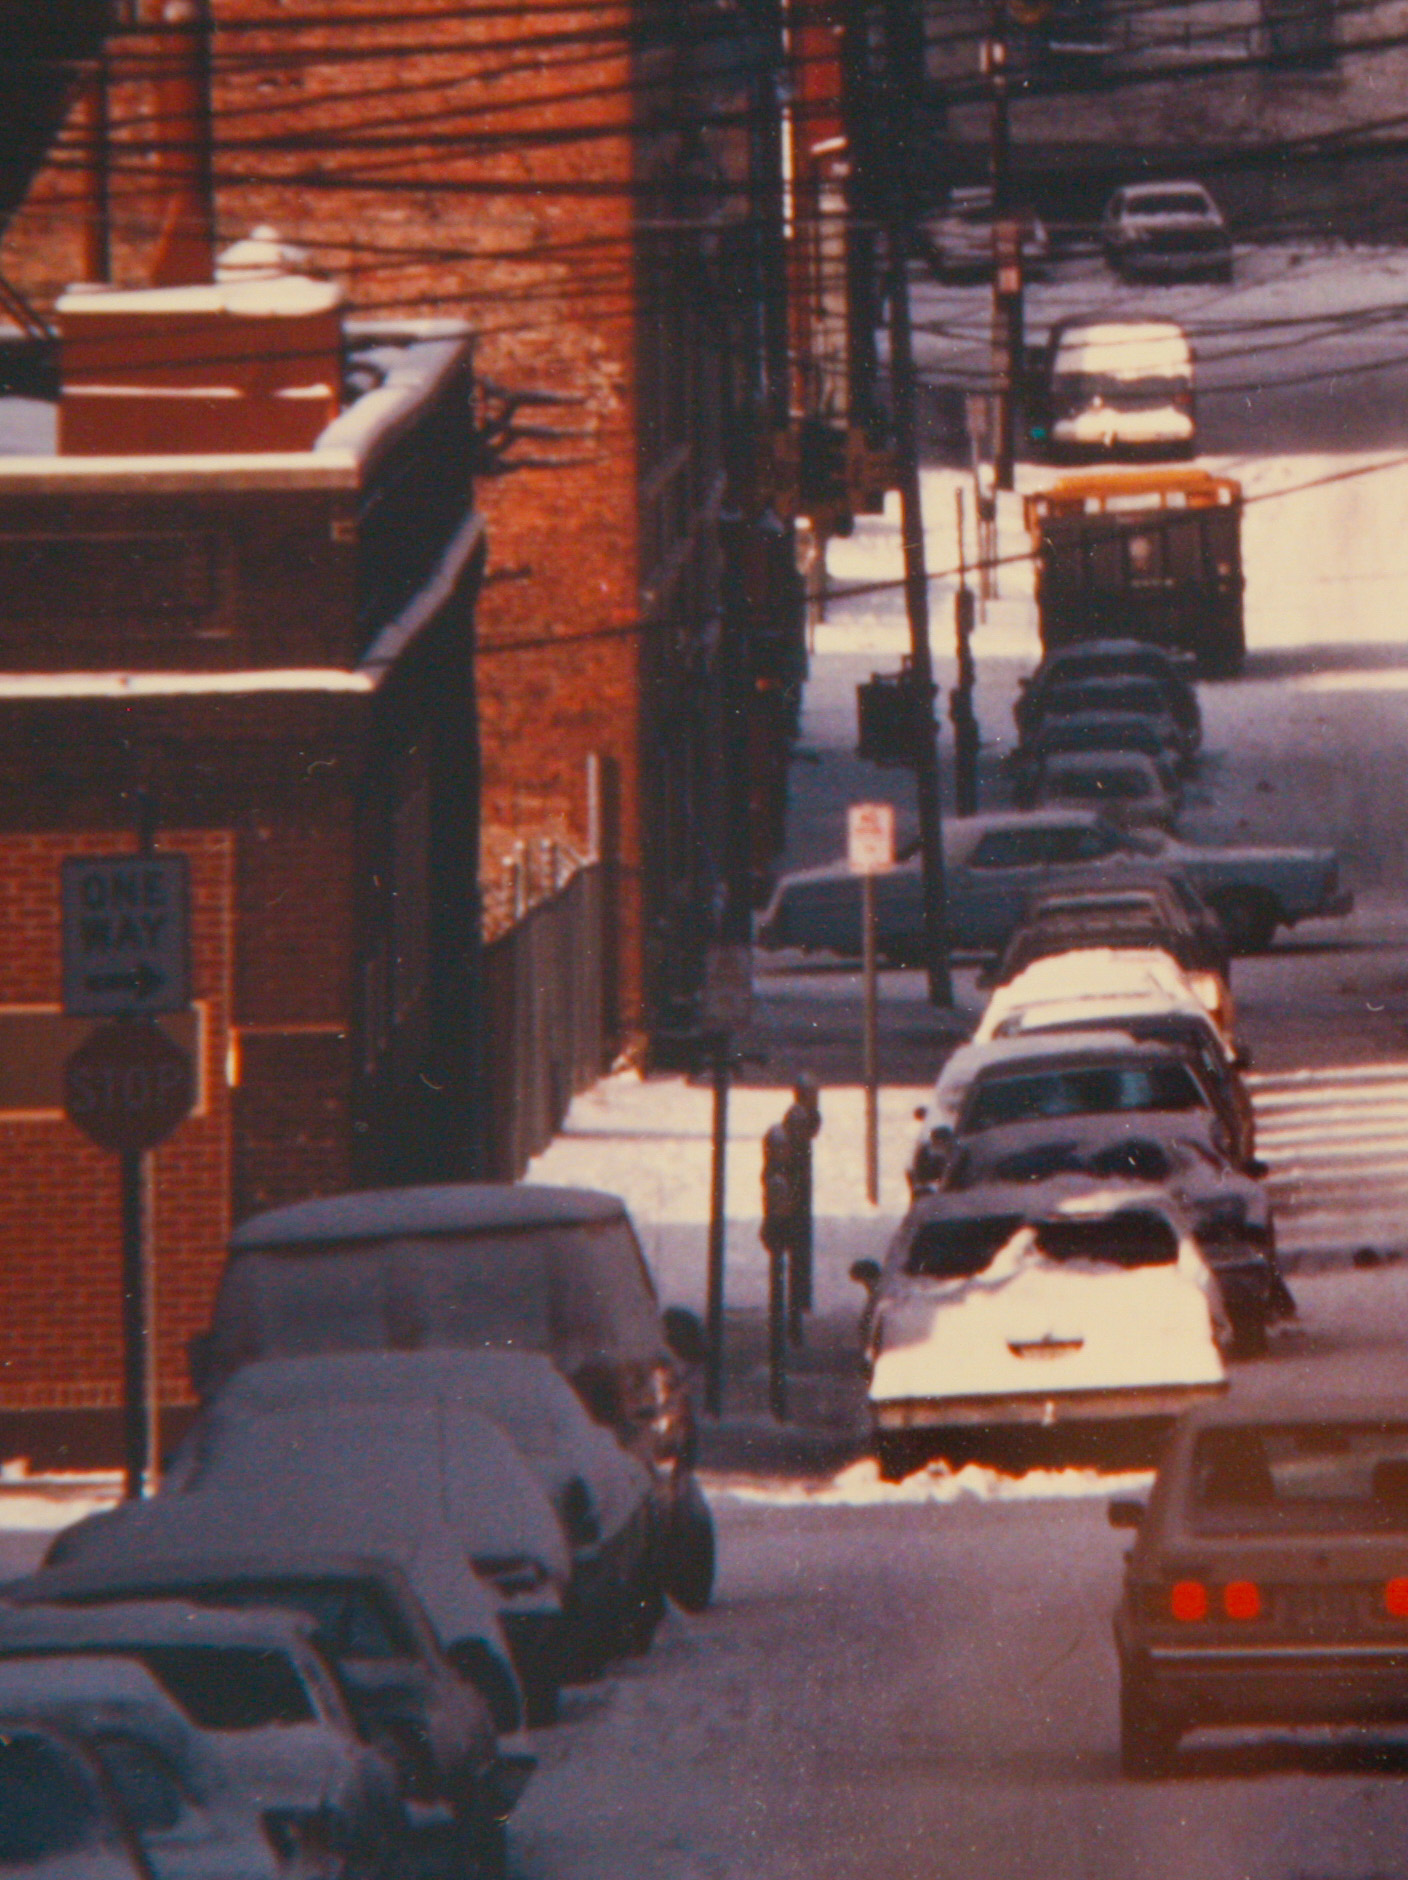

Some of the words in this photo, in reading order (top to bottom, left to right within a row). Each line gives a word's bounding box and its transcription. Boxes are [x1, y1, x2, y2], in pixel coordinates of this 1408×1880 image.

[80, 870, 164, 908] ONE
[79, 914, 166, 952] WAY
[70, 1064, 181, 1114] STOP
